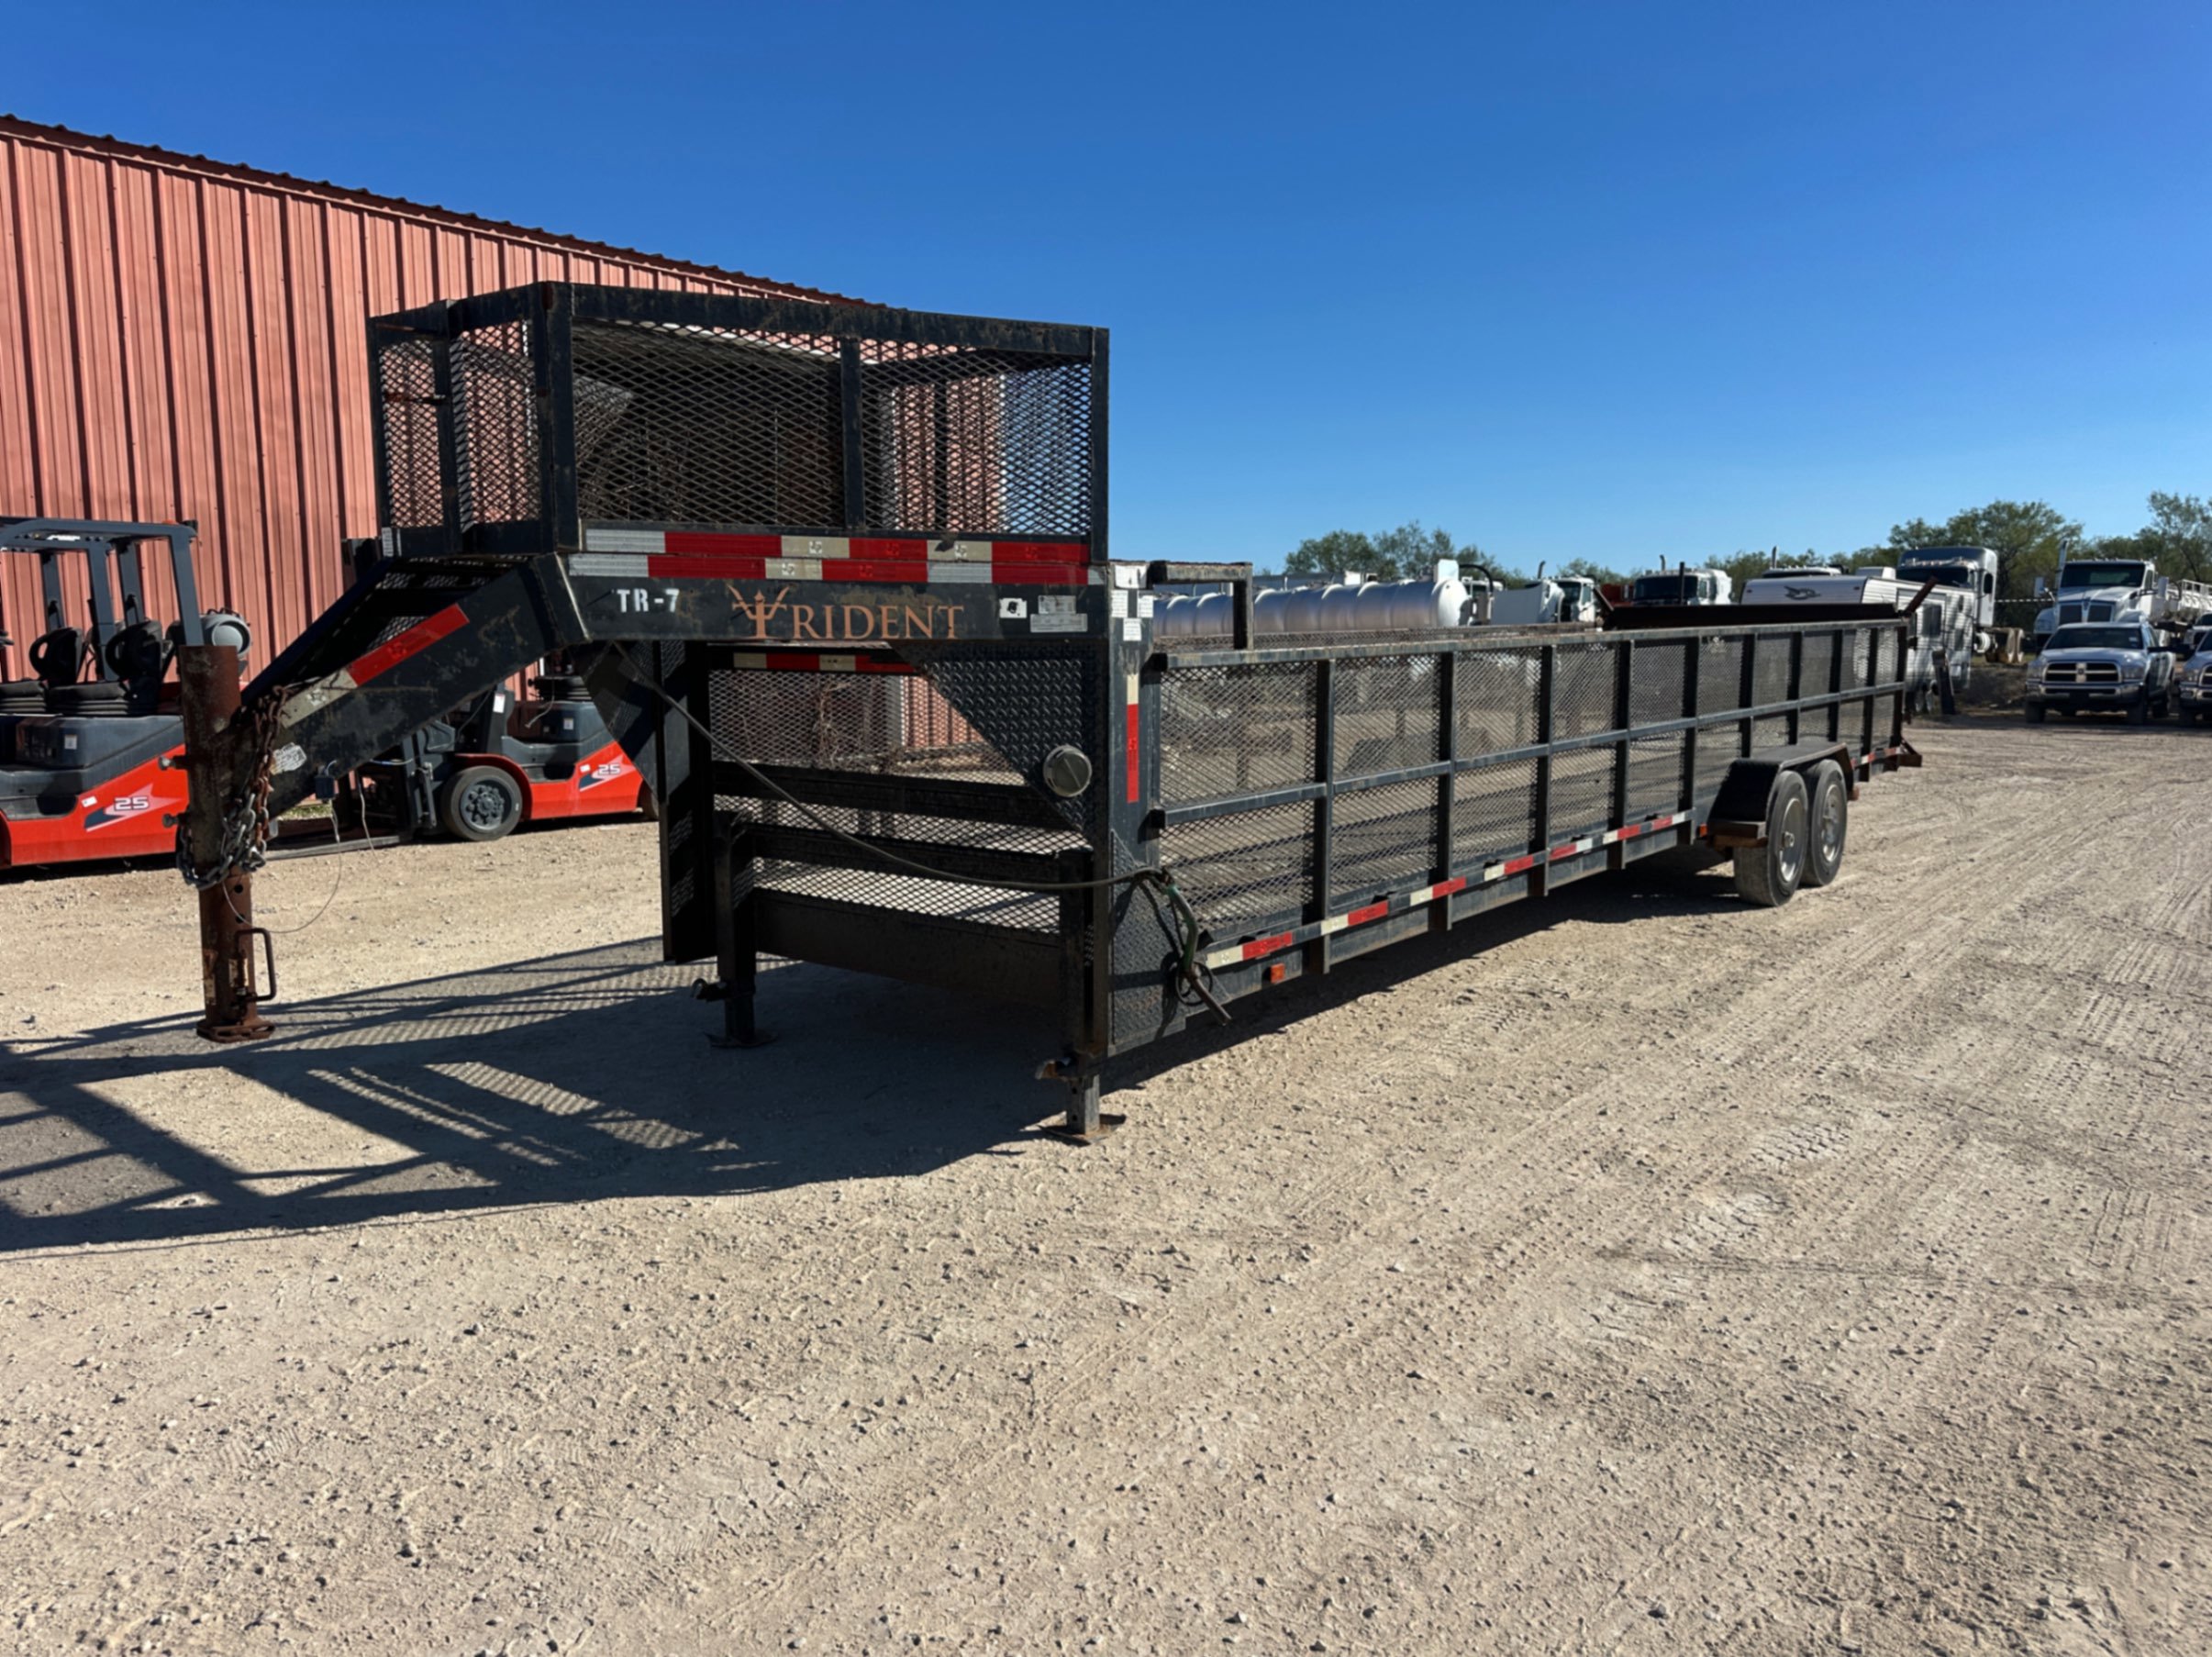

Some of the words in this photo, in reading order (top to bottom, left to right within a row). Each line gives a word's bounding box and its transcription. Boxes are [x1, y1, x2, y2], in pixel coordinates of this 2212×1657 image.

[617, 588, 680, 613] TR-7
[598, 763, 621, 775] 25
[114, 796, 150, 811] 25
